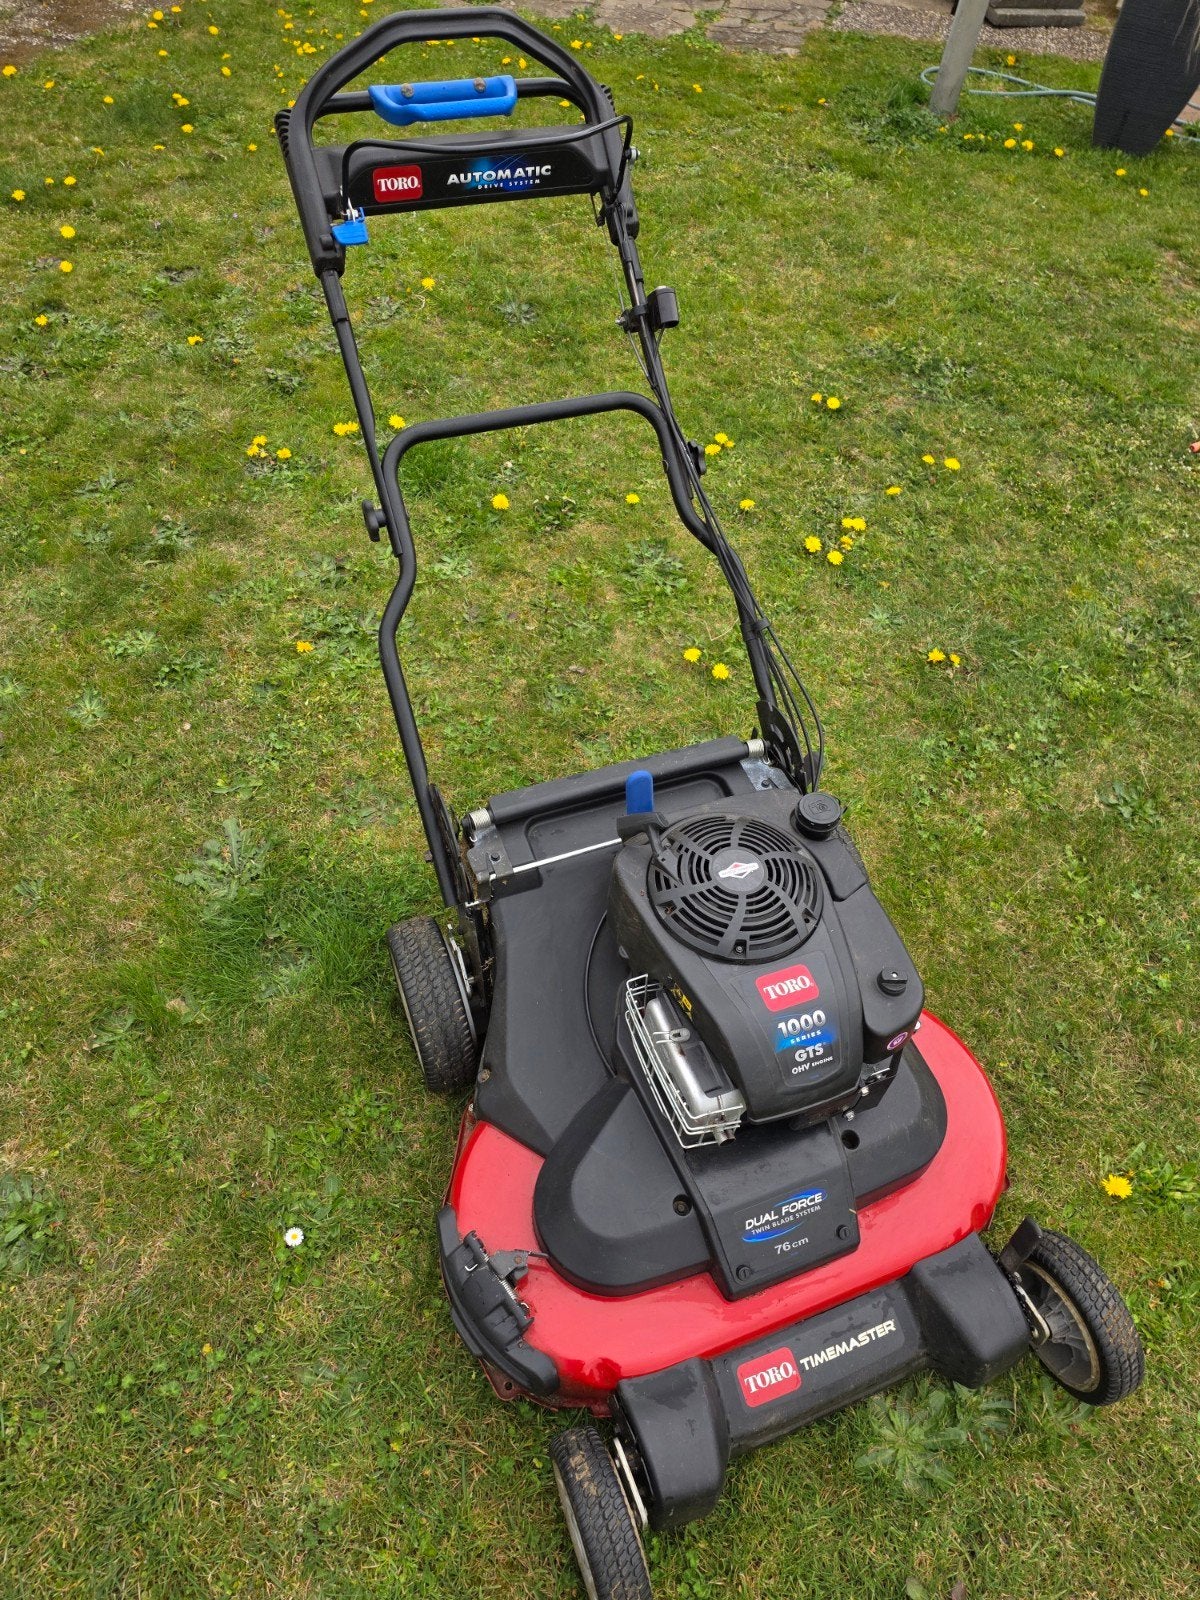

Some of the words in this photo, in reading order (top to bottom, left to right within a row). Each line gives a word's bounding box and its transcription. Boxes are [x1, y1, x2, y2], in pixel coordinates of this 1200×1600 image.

[377, 175, 419, 192] TORO
[446, 165, 552, 185] AUTOMATIC
[477, 182, 504, 190] DRIVE
[509, 179, 541, 187] SYSTEM
[763, 975, 811, 1000] TORO
[777, 1009, 826, 1038] 1000
[790, 1029, 822, 1044] SERIES
[794, 1043, 824, 1062] GTS
[791, 1062, 810, 1075] OHV
[811, 1055, 834, 1067] ENGINE
[745, 1210, 779, 1230] DUAL
[782, 1192, 823, 1216] FORCE
[752, 1225, 771, 1235] TWIN
[772, 1215, 794, 1228] BLADE
[796, 1205, 821, 1219] SYSTEM
[774, 1241, 791, 1255] 76
[791, 1237, 810, 1248] cm
[800, 1319, 897, 1371] TIMEMASTER
[744, 1361, 794, 1393] TORO
